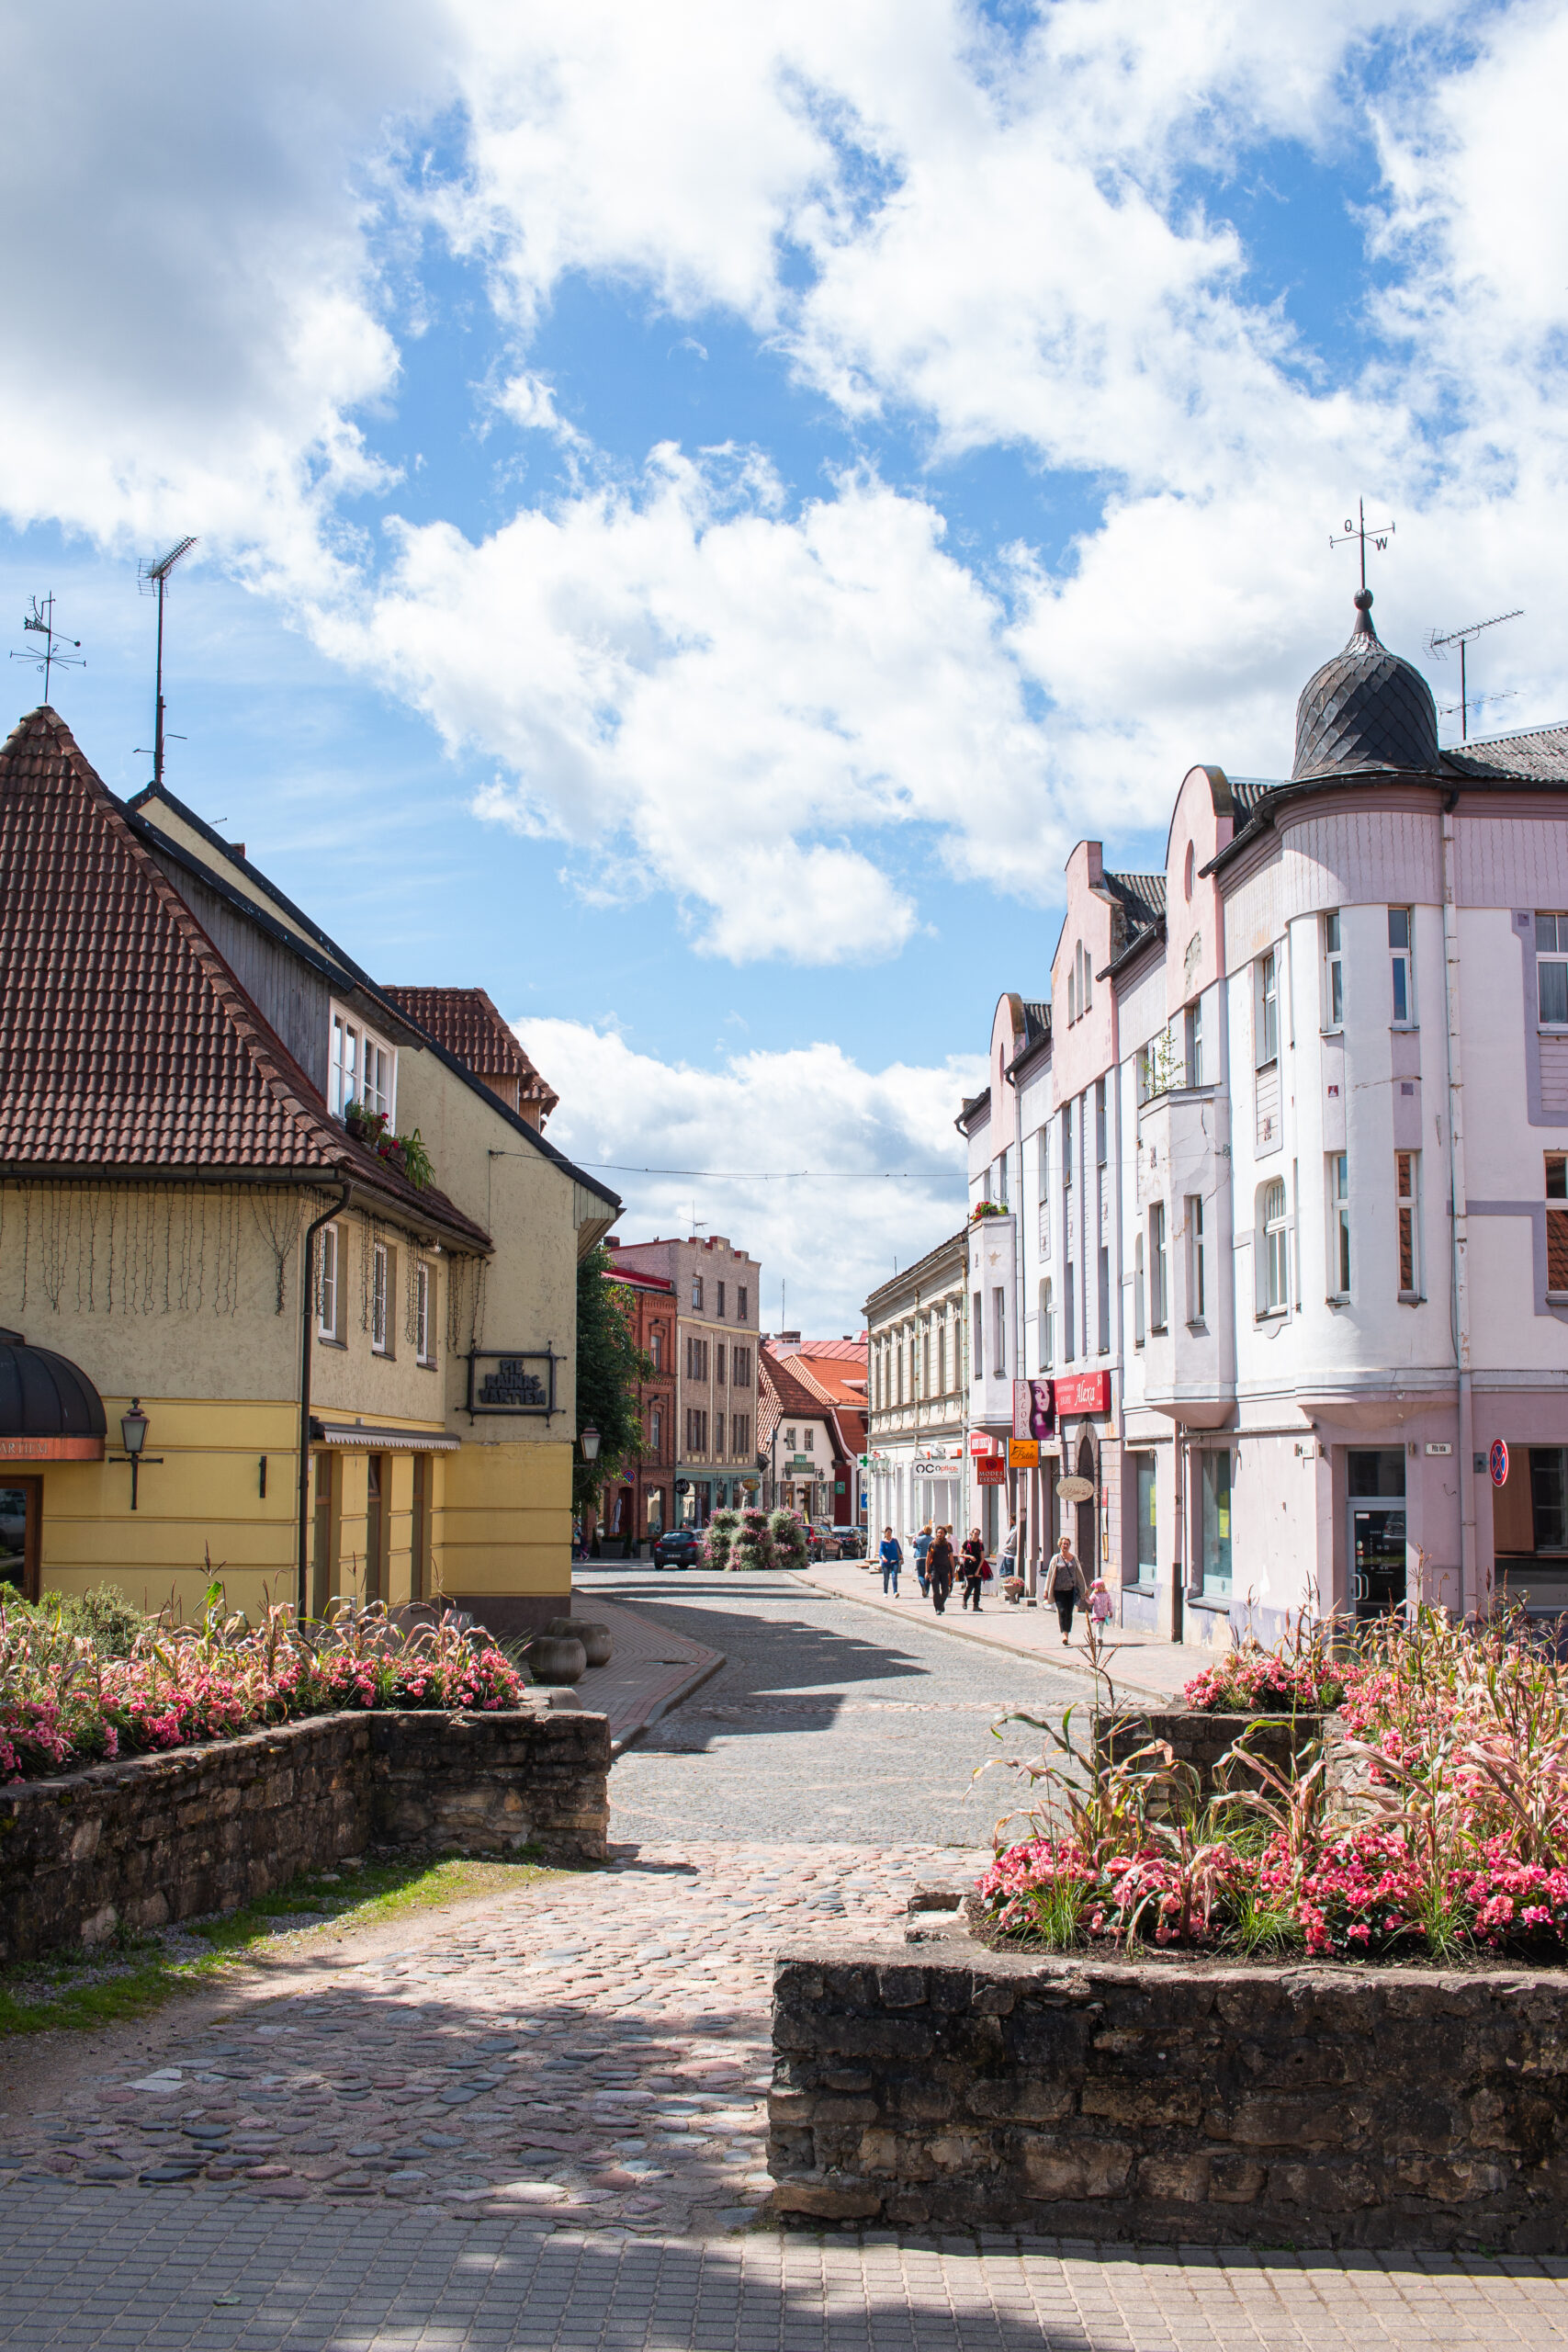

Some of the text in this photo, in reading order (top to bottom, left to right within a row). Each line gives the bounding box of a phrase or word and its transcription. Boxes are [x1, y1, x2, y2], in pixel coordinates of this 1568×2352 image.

[500, 1360, 525, 1374] PIE
[485, 1374, 542, 1389] RAUNAS
[1074, 1379, 1095, 1407] Alexa
